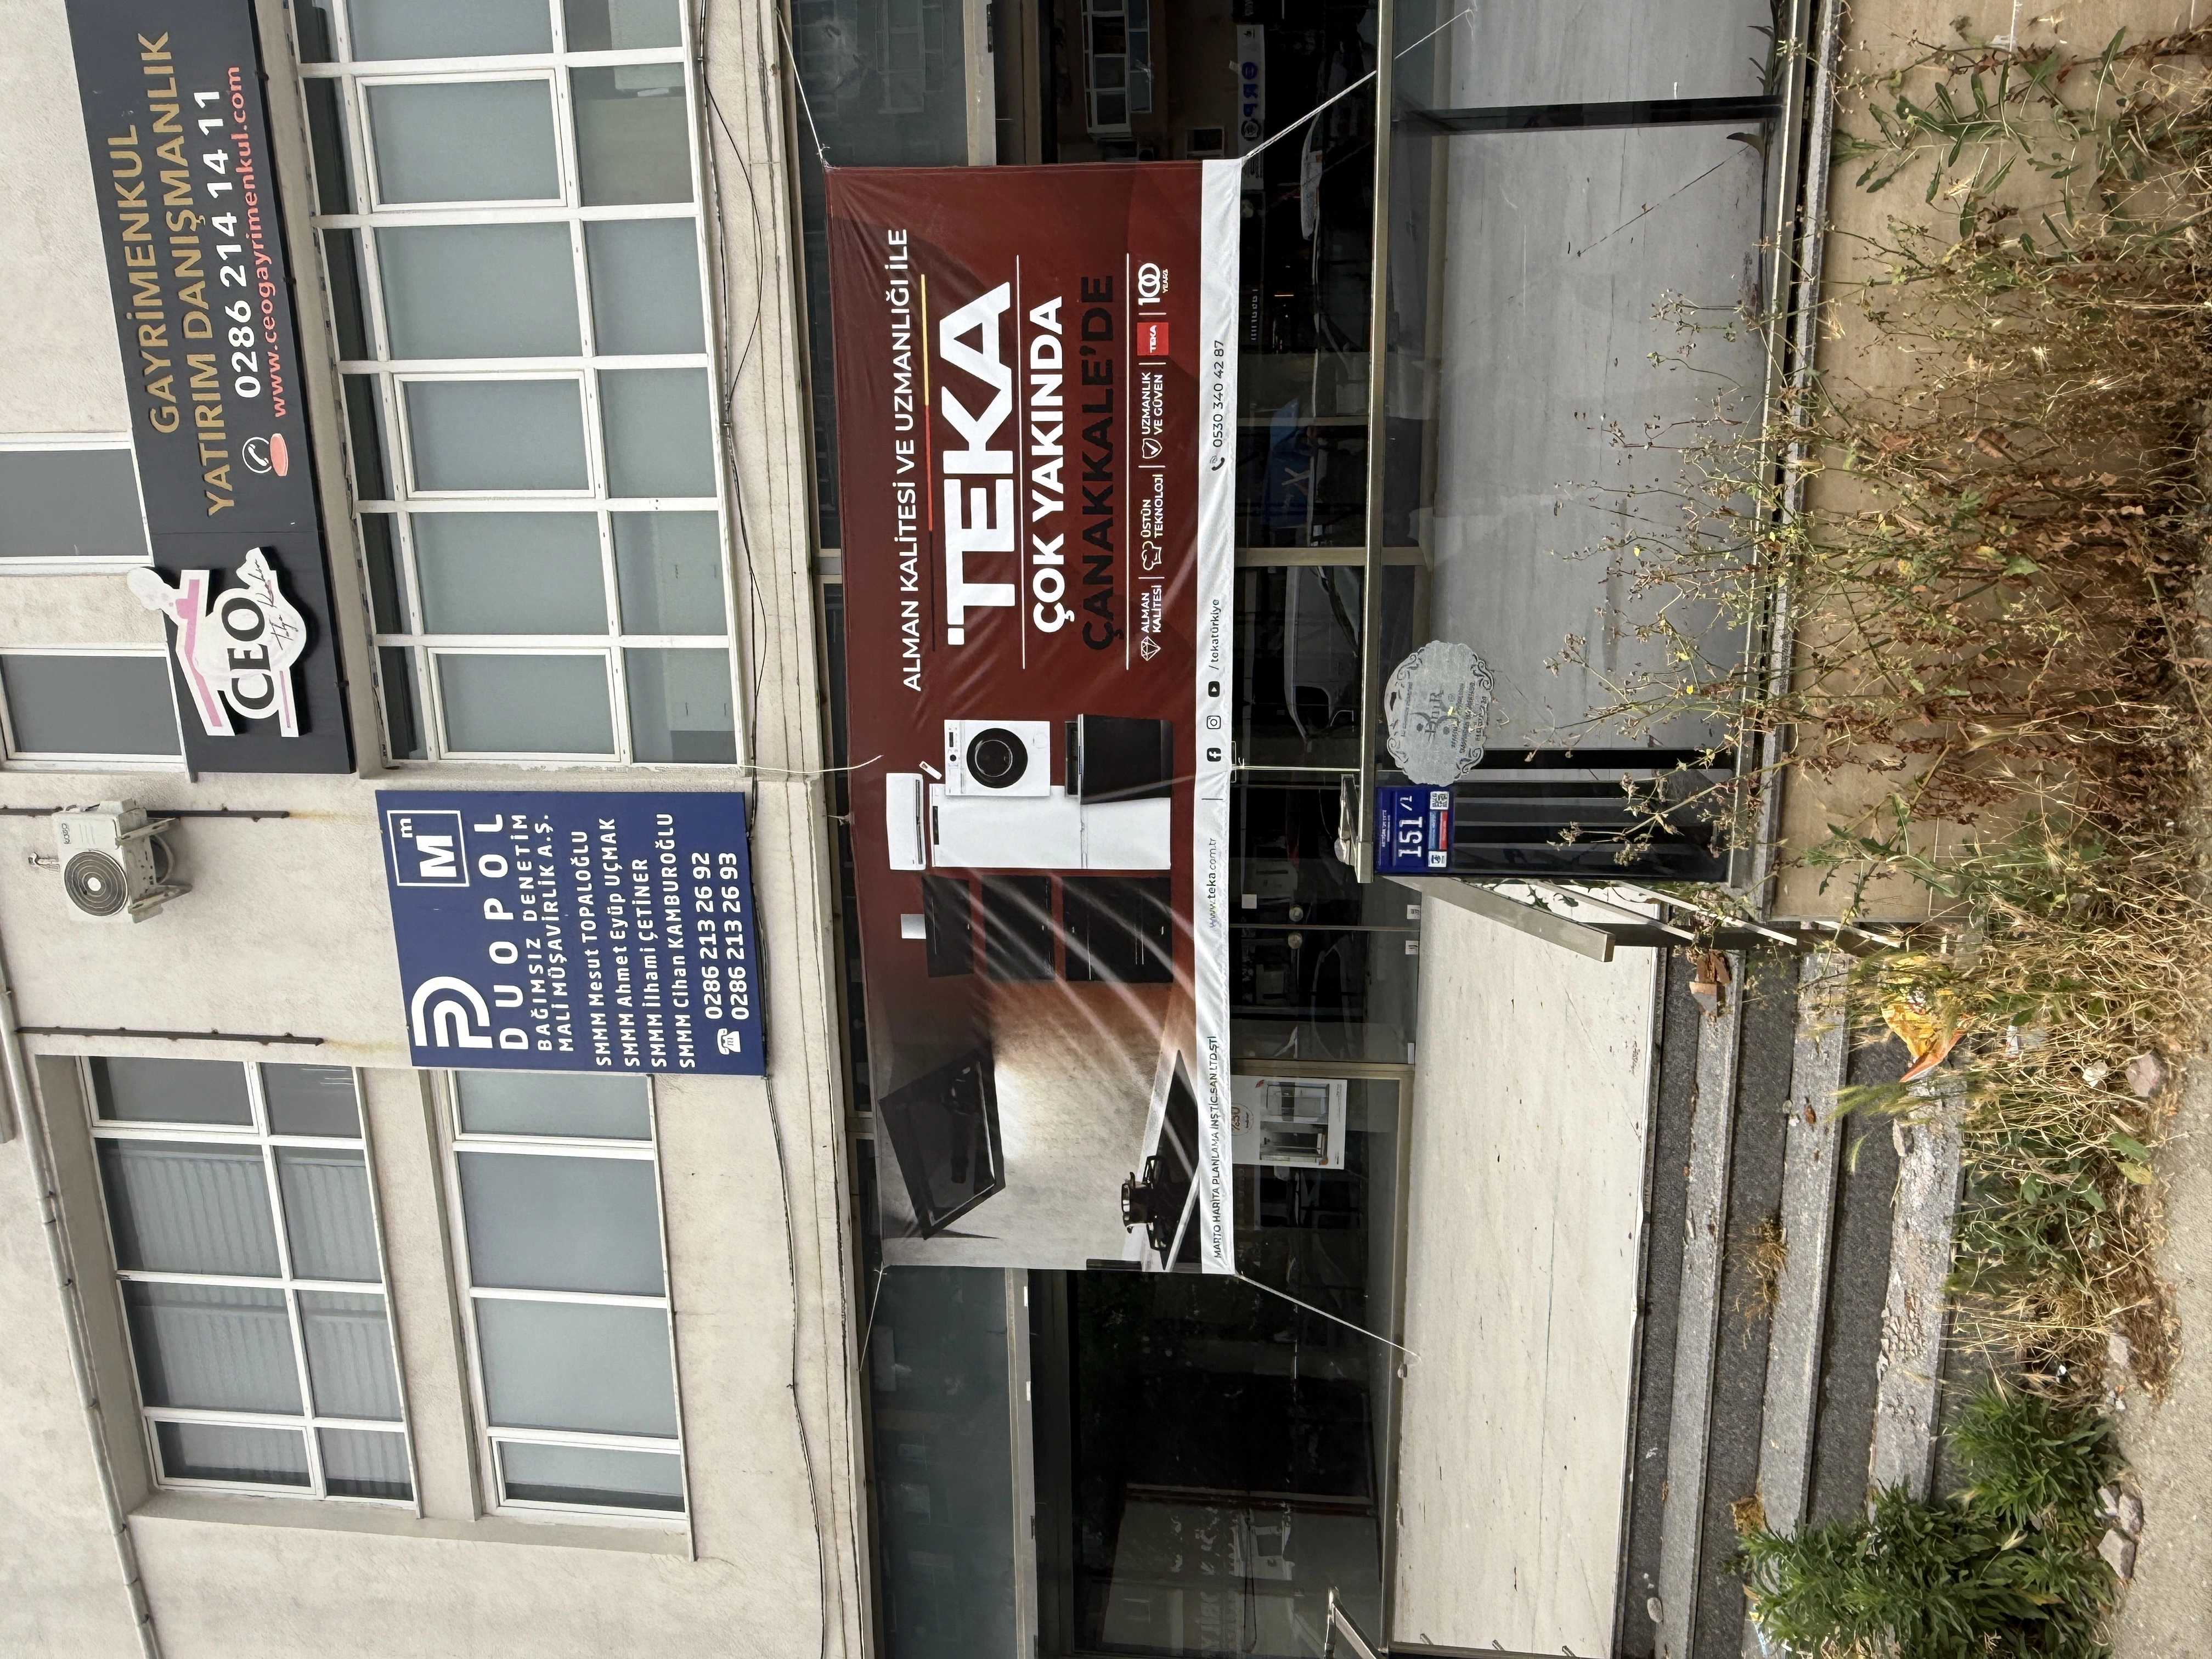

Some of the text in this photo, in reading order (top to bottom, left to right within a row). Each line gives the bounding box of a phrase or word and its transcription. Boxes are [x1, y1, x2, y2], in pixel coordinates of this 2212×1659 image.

[108, 125, 179, 433] GAYRİMENKUL
[138, 32, 234, 517] YATIRIM DANIŞMANLIK
[194, 92, 261, 398] 0286 214 14 11
[228, 67, 286, 417] www.ceogayrimenkul.com
[1138, 263, 1160, 305] 100
[885, 229, 921, 691] ALMAN KALİTESİ VE UZMANLIĞI İLE
[939, 281, 1015, 645] TEKA
[1030, 296, 1074, 633] ÇOK YAKINDA
[1142, 373, 1150, 434] UZMANLIK
[1153, 375, 1163, 435] VE GÜVEN
[1213, 341, 1223, 447] 0530 340 42 87
[1141, 500, 1151, 537] ÜSTÜN
[1153, 475, 1163, 538] TEKNOLOJİ
[222, 597, 274, 709] CEO
[1141, 593, 1149, 633] ALMAN
[1152, 585, 1162, 632] KALİTESİ
[1398, 817, 1422, 857] 151
[474, 815, 528, 1049] DUOPOL
[511, 815, 552, 1050] BAĞIMSIZ DENETİM
[535, 815, 573, 1051] MALİ MÜŞAVİRLİK A.Ş.
[572, 832, 611, 1065] SMMM Mesut TOPALOĞLU
[599, 819, 640, 1066] SMMM Ahmet Eyüp UÇMAK
[632, 860, 667, 1066] SMMM İlhami ÇETİNER
[656, 814, 695, 1068] SMMM Cihan KAMBUROĞLU
[692, 853, 723, 1019] 0286 213 26 92
[719, 853, 749, 1019] 0286 213 26 93
[1210, 1188, 1220, 1222] HARİTA
[1211, 1132, 1220, 1184] PLANLAMA
